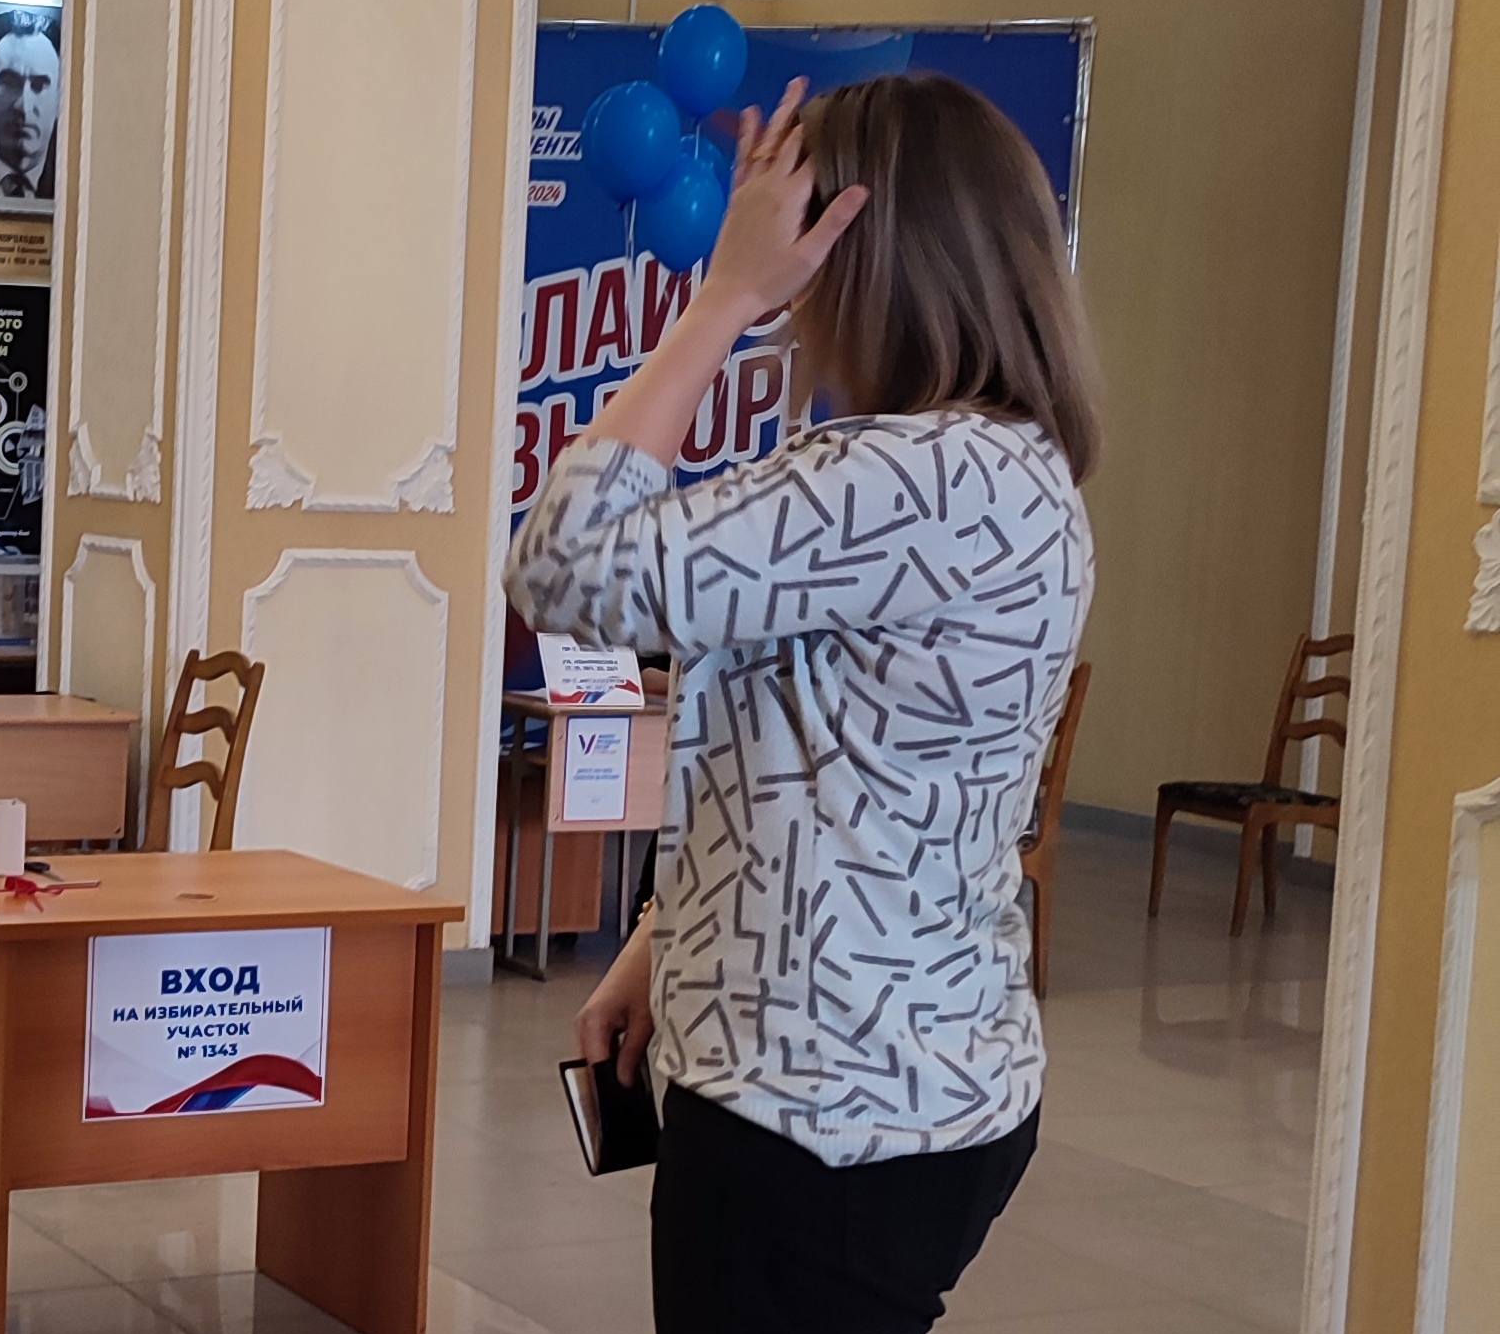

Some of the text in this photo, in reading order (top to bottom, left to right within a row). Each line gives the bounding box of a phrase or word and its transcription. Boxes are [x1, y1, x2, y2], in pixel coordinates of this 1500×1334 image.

[530, 136, 580, 156] ЕНТА
[528, 185, 561, 203] 2024
[160, 965, 261, 996] ВХОД
[113, 995, 303, 1023] НА ИЗБИРАТЕЛЬНЫЙ
[167, 1021, 251, 1040] УЧАСТОК
[178, 1043, 238, 1059] № 1343
